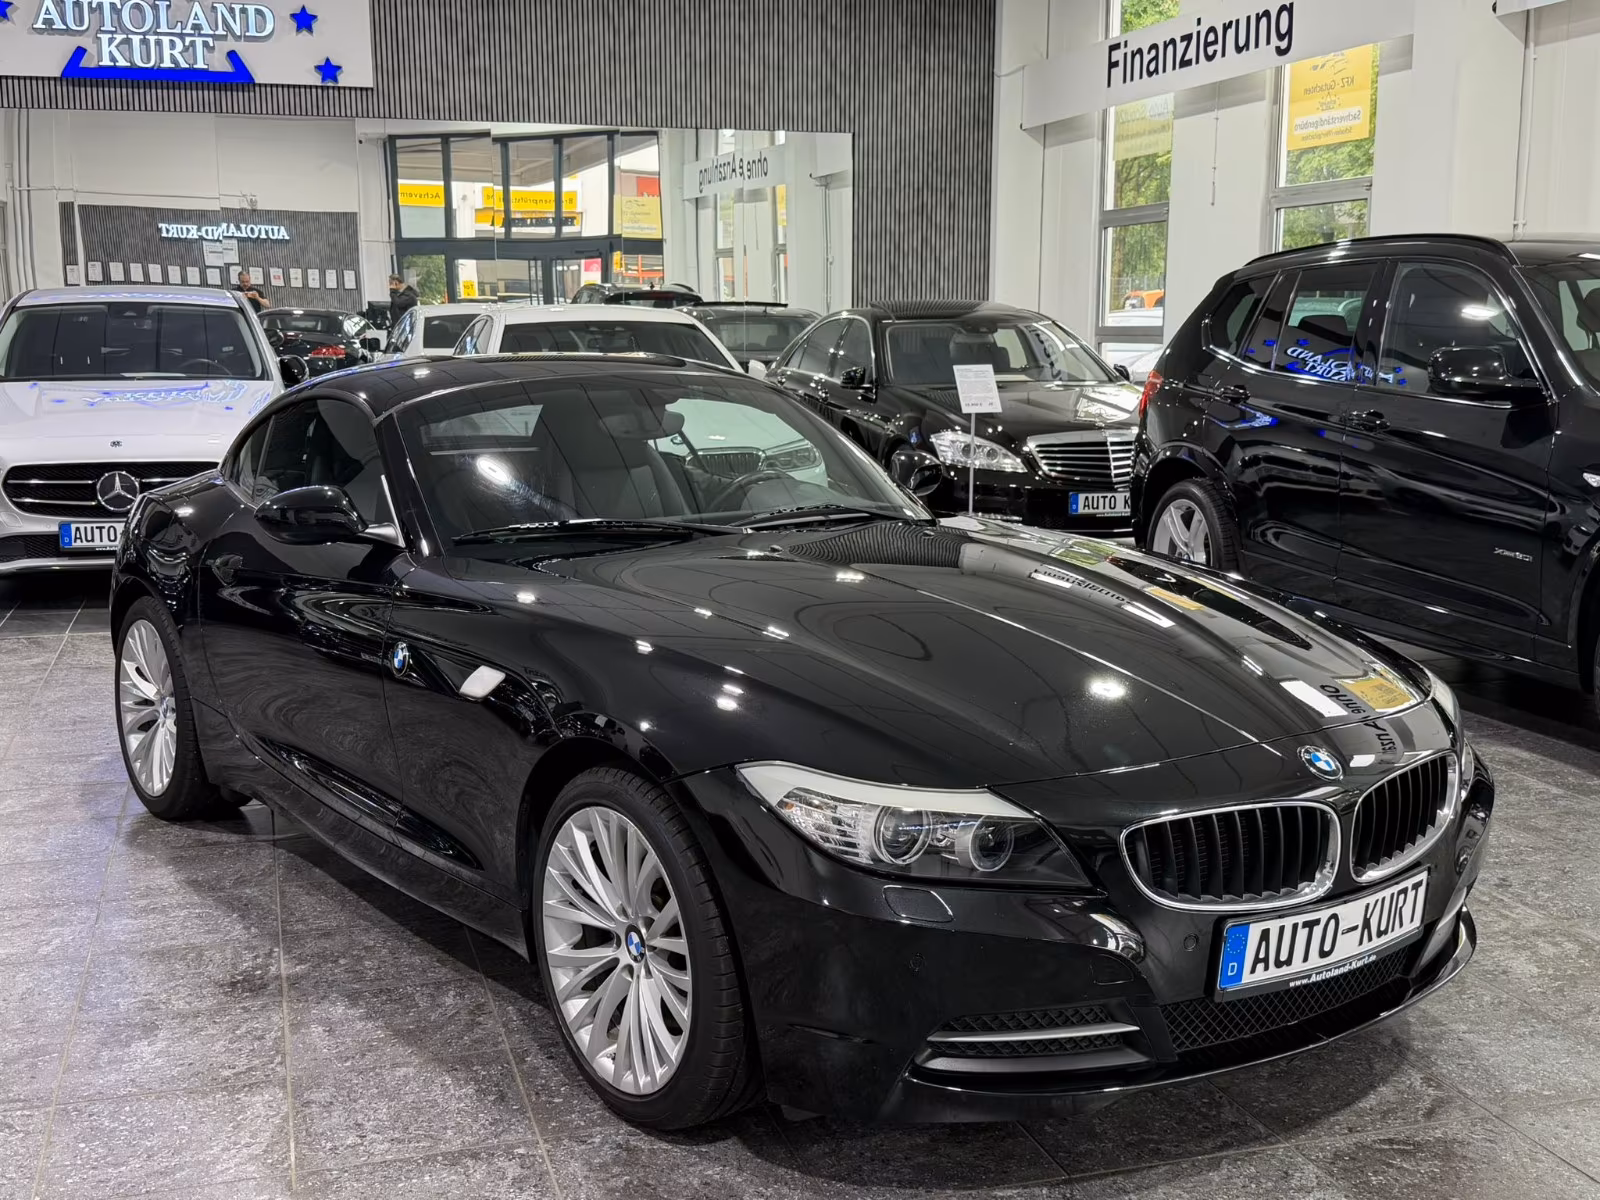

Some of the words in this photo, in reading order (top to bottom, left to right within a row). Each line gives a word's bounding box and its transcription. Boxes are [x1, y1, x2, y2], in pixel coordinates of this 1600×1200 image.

[32, 0, 275, 37] AUTOLAND
[97, 33, 214, 69] KURT
[1106, 1, 1295, 89] Finanzierung
[1083, 495, 1117, 510] AUTO
[73, 525, 118, 543] AUTO
[1227, 962, 1238, 976] D
[1250, 879, 1424, 975] AUTO-KURT
[1289, 953, 1377, 988] www.Autoland-Kurt.de
